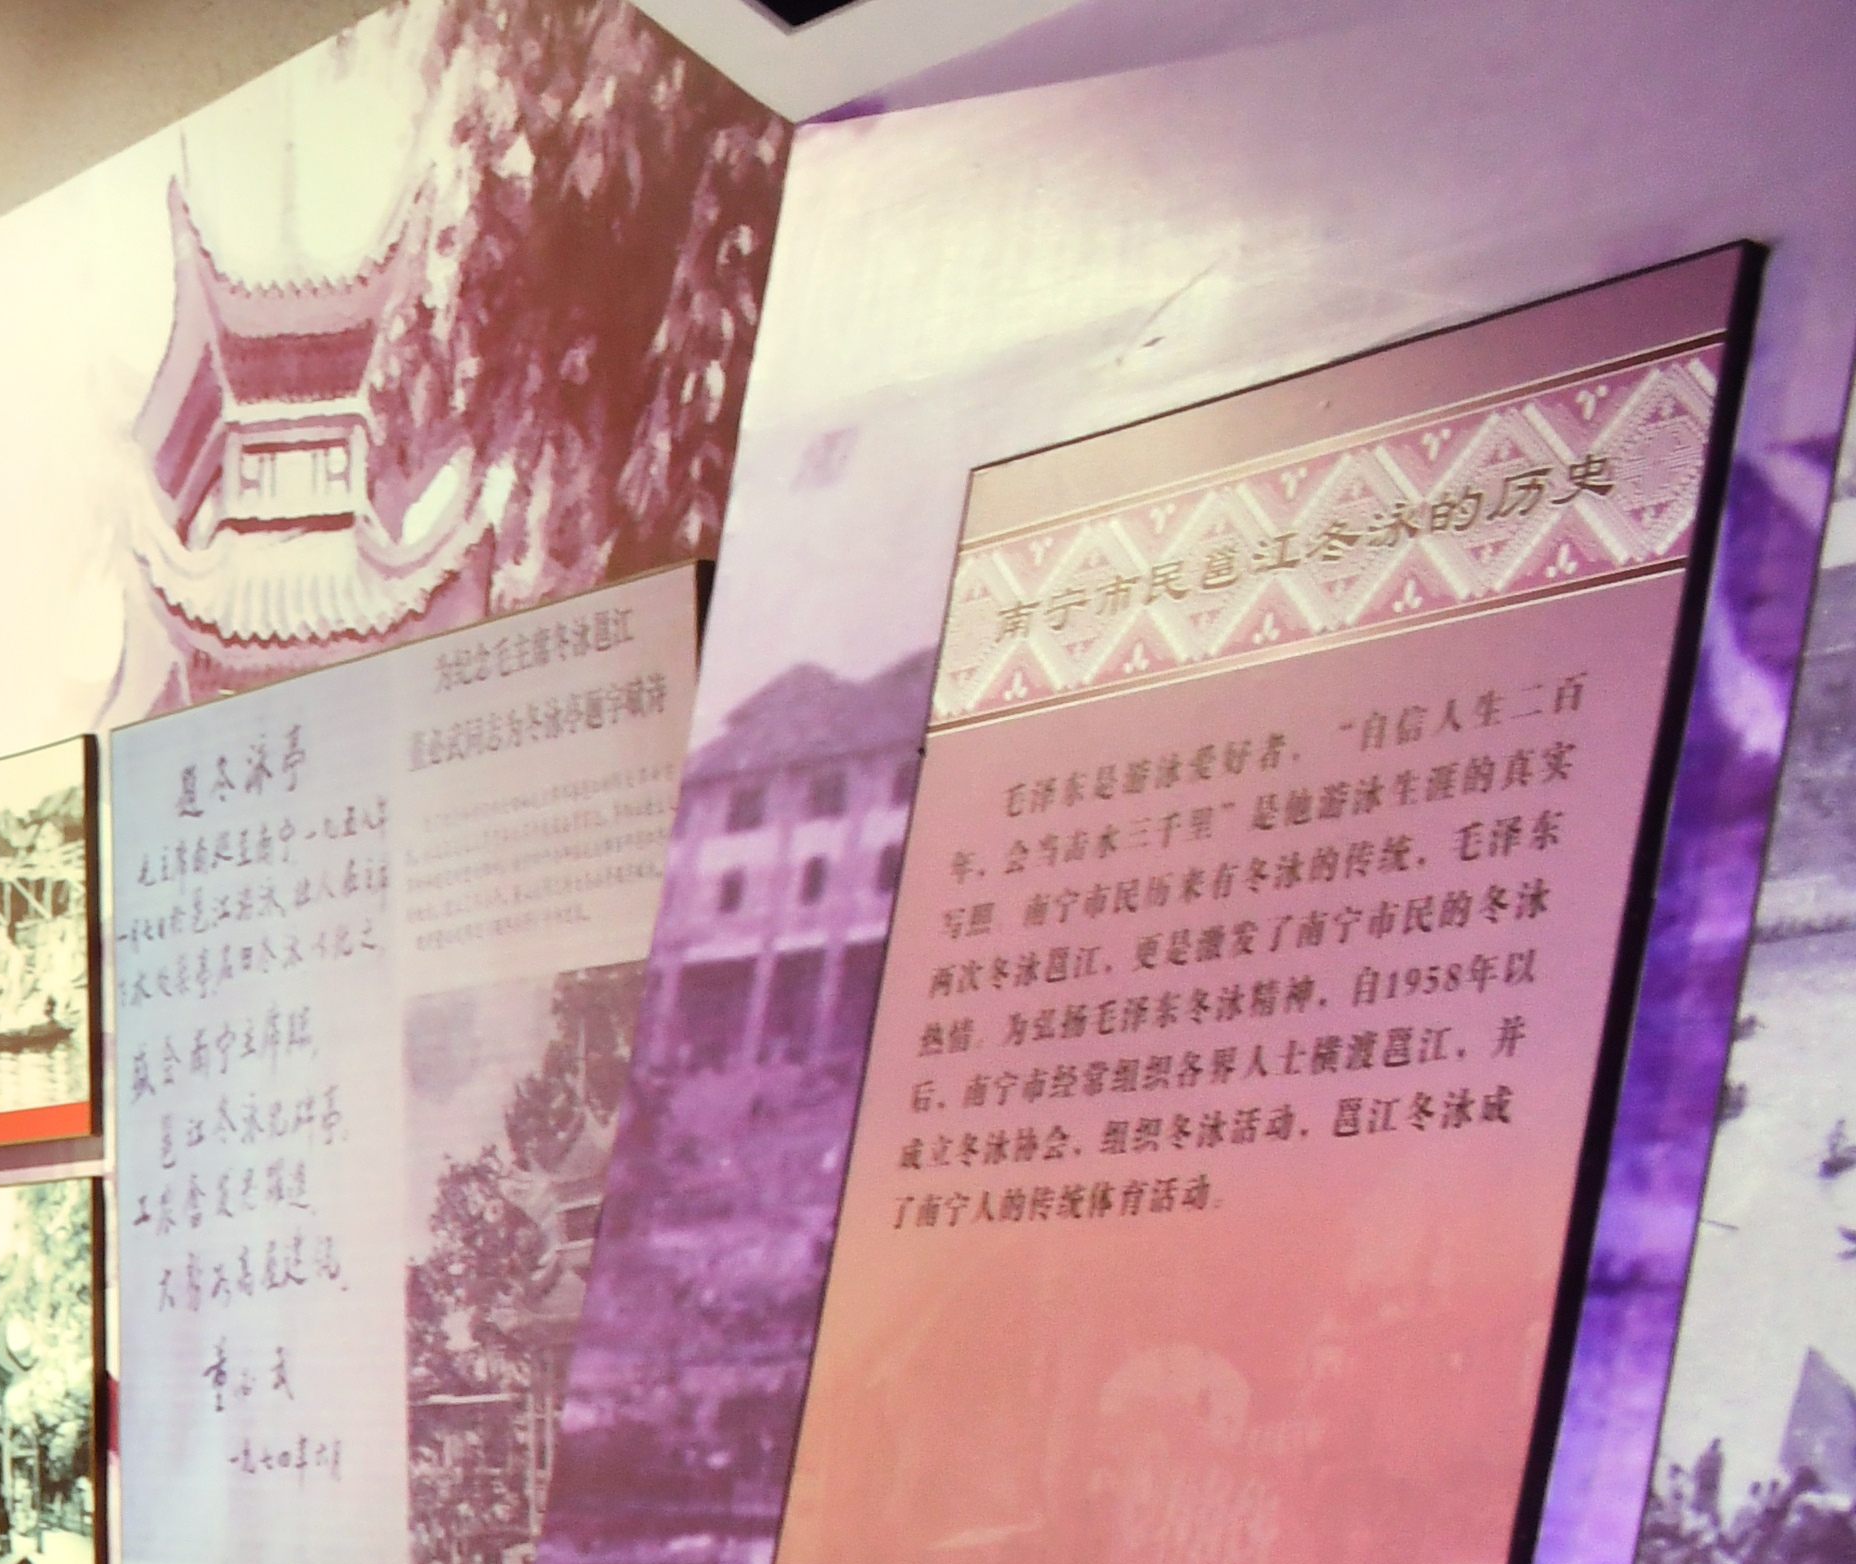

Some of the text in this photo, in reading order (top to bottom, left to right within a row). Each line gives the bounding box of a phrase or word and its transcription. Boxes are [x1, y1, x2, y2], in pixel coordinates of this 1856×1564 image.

[993, 452, 1617, 645] 南宁市民邕江冬泳的历史
